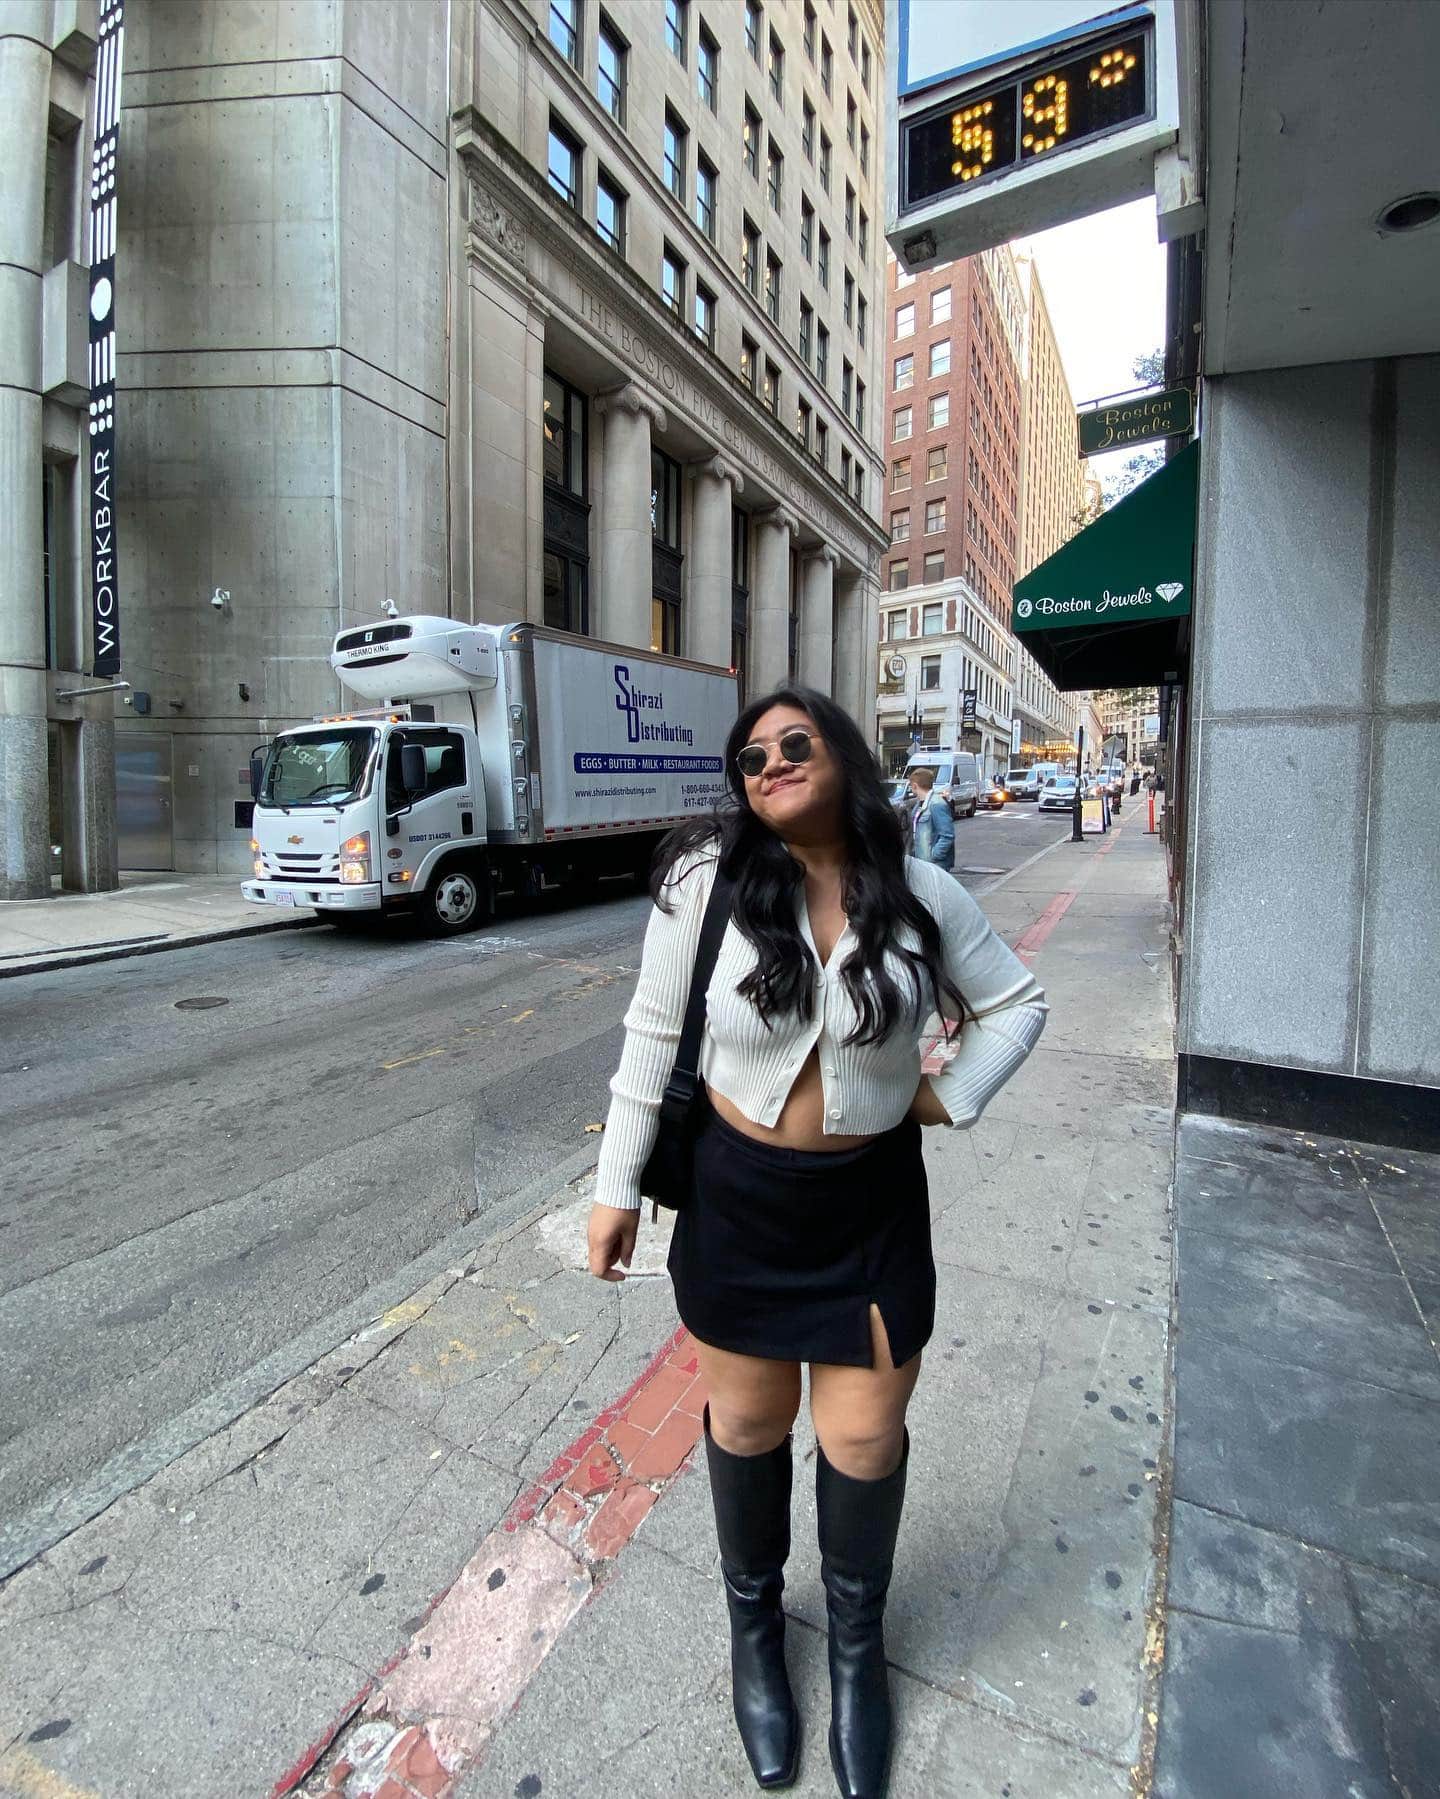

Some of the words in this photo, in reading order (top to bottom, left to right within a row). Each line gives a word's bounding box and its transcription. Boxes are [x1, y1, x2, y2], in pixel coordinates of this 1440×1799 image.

[576, 282, 613, 339] THE
[621, 323, 685, 400] BOSTON
[693, 389, 719, 431] FIVE
[722, 418, 760, 467] CENTS
[762, 454, 801, 503] SAVINGS
[803, 490, 825, 525] BANK
[1095, 400, 1173, 426] Boston
[1097, 416, 1172, 449] Jewels
[94, 448, 115, 656] WORKBAR
[1035, 596, 1092, 615] Boston
[1095, 586, 1152, 613] Jewels
[346, 646, 373, 658] THERMO
[374, 643, 390, 654] KING
[614, 664, 663, 711] Shirazi
[626, 706, 694, 747] Distributing
[580, 757, 603, 769] EGGS
[608, 758, 637, 769] BUTTER
[641, 759, 659, 769] MILK
[663, 760, 702, 770] RESTAURANT
[702, 761, 720, 770] FOODS
[574, 786, 657, 798] www.shirazidistributing.com
